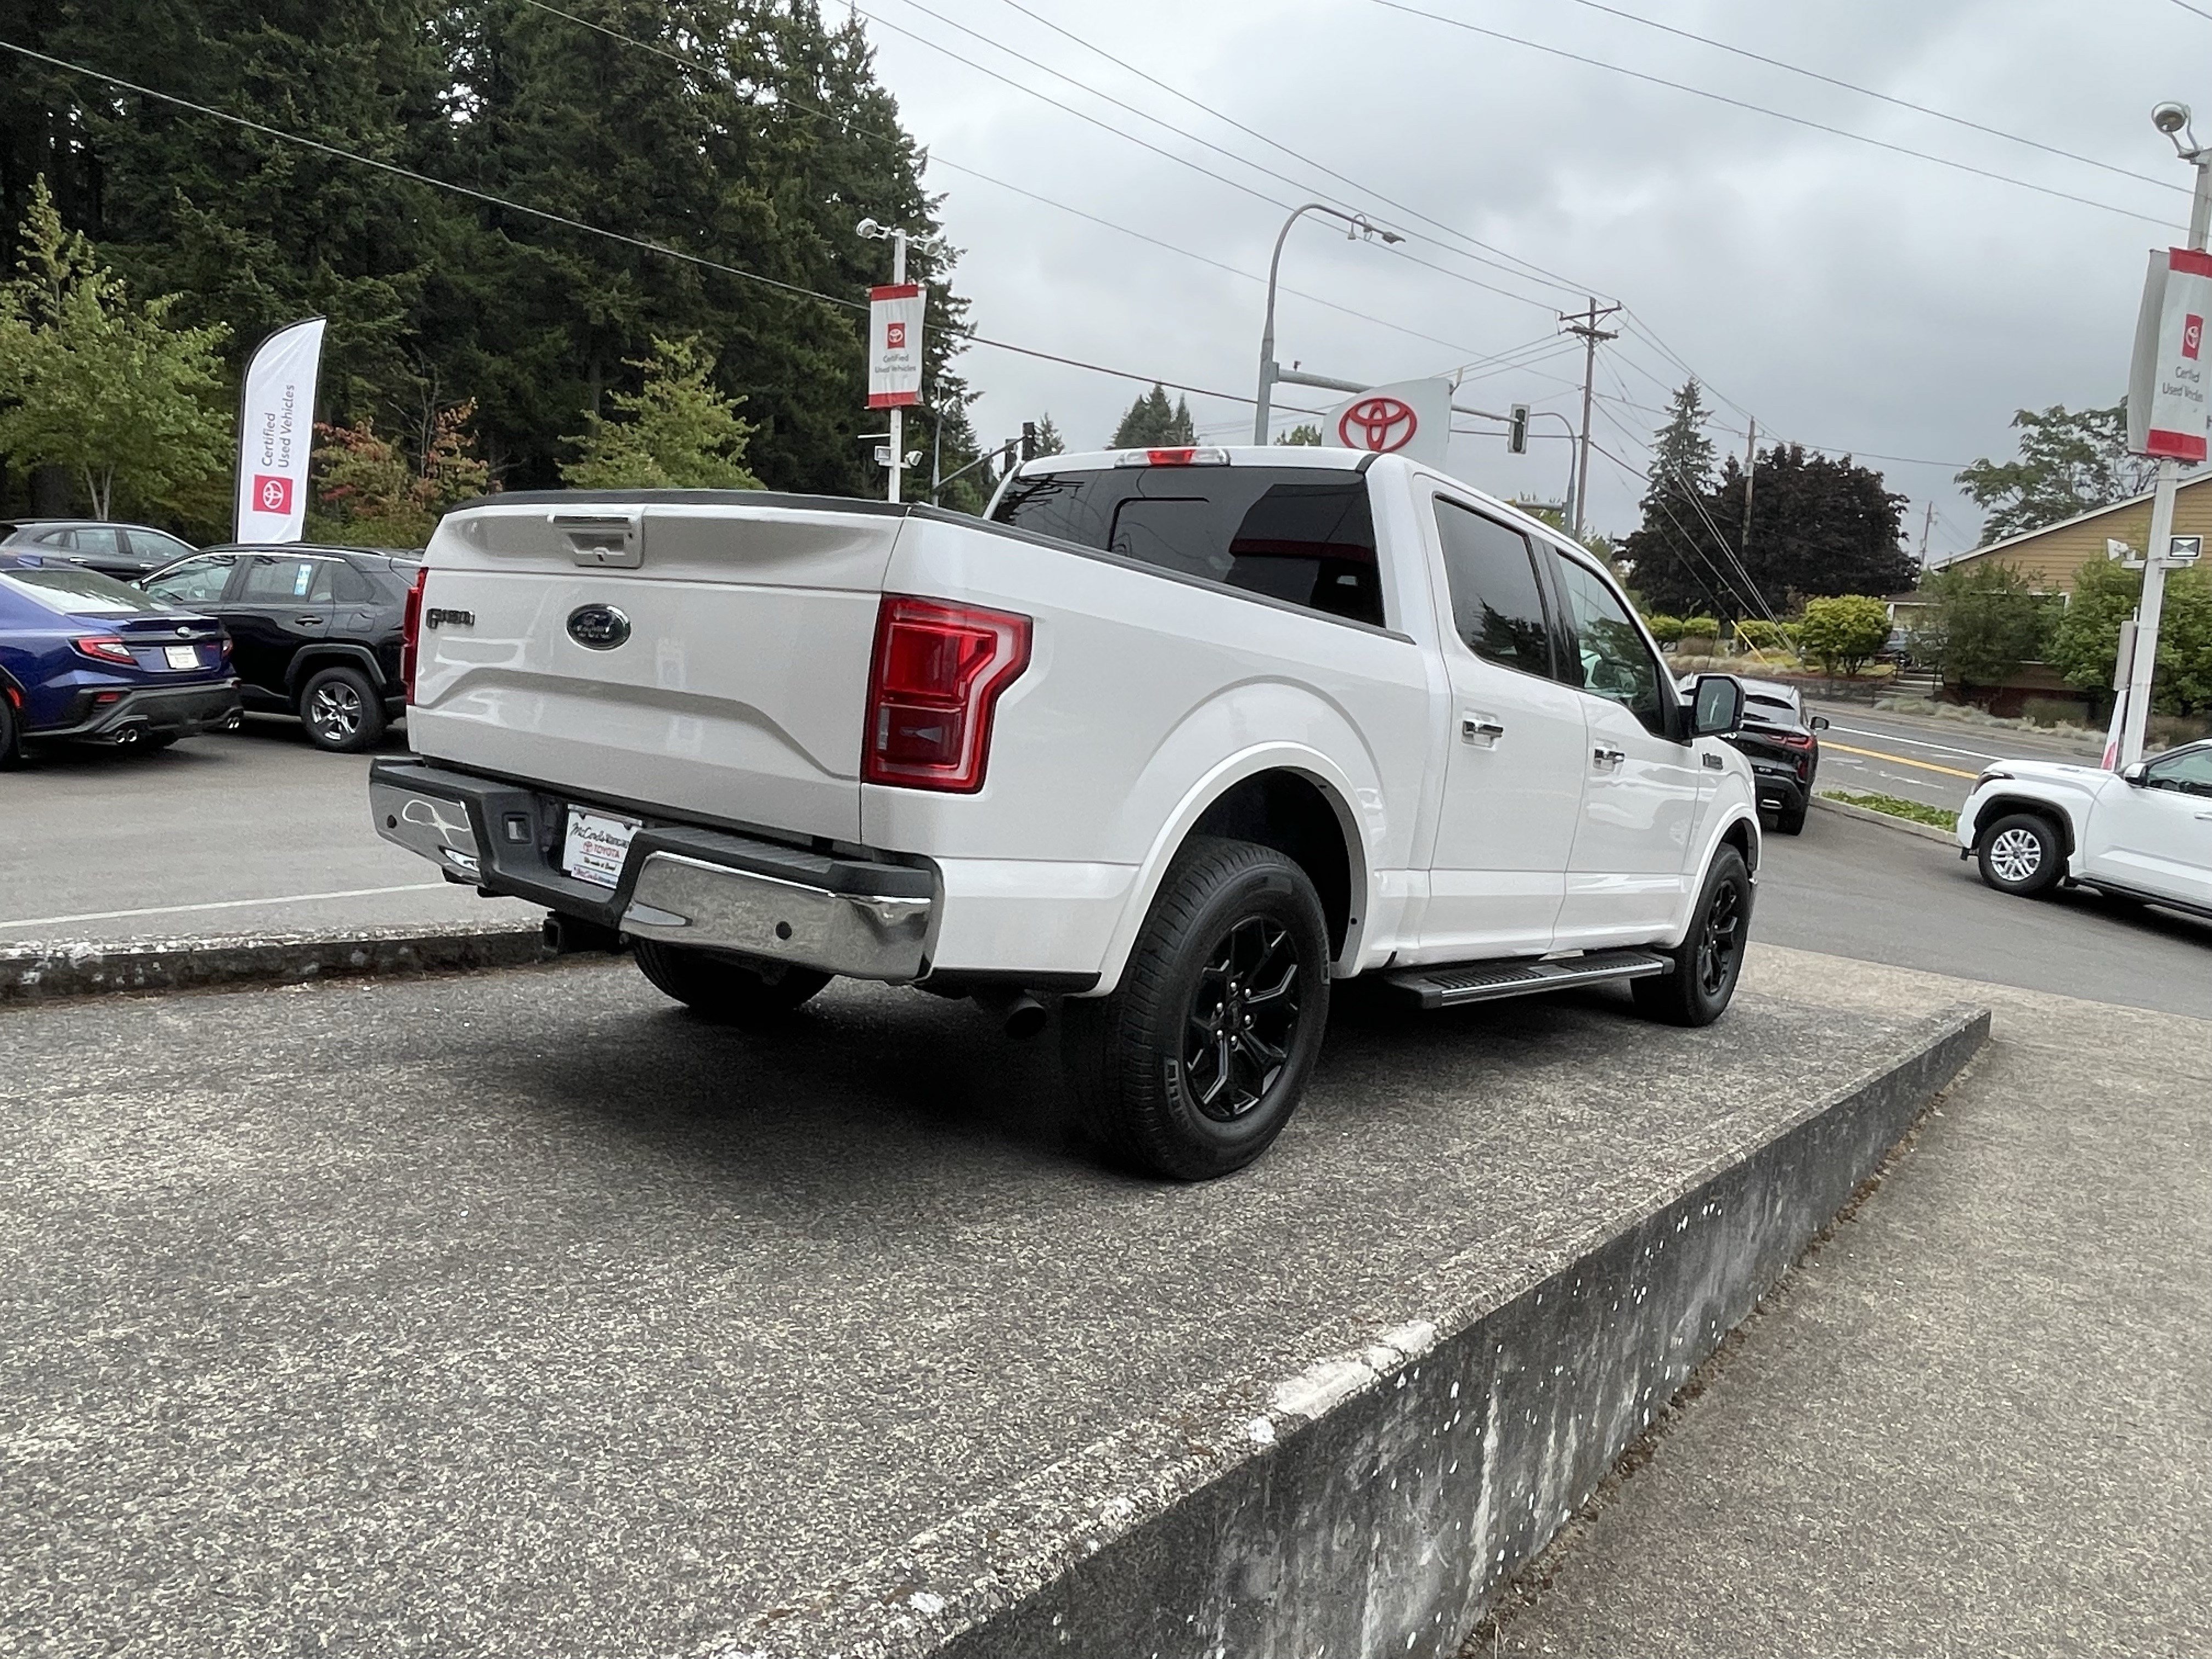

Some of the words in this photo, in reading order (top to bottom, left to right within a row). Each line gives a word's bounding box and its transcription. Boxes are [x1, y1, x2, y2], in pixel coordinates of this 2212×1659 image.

[280, 385, 295, 434] Vehicles
[262, 413, 275, 466] Certified
[278, 437, 291, 467] Used
[594, 844, 620, 859] TOYOTA
